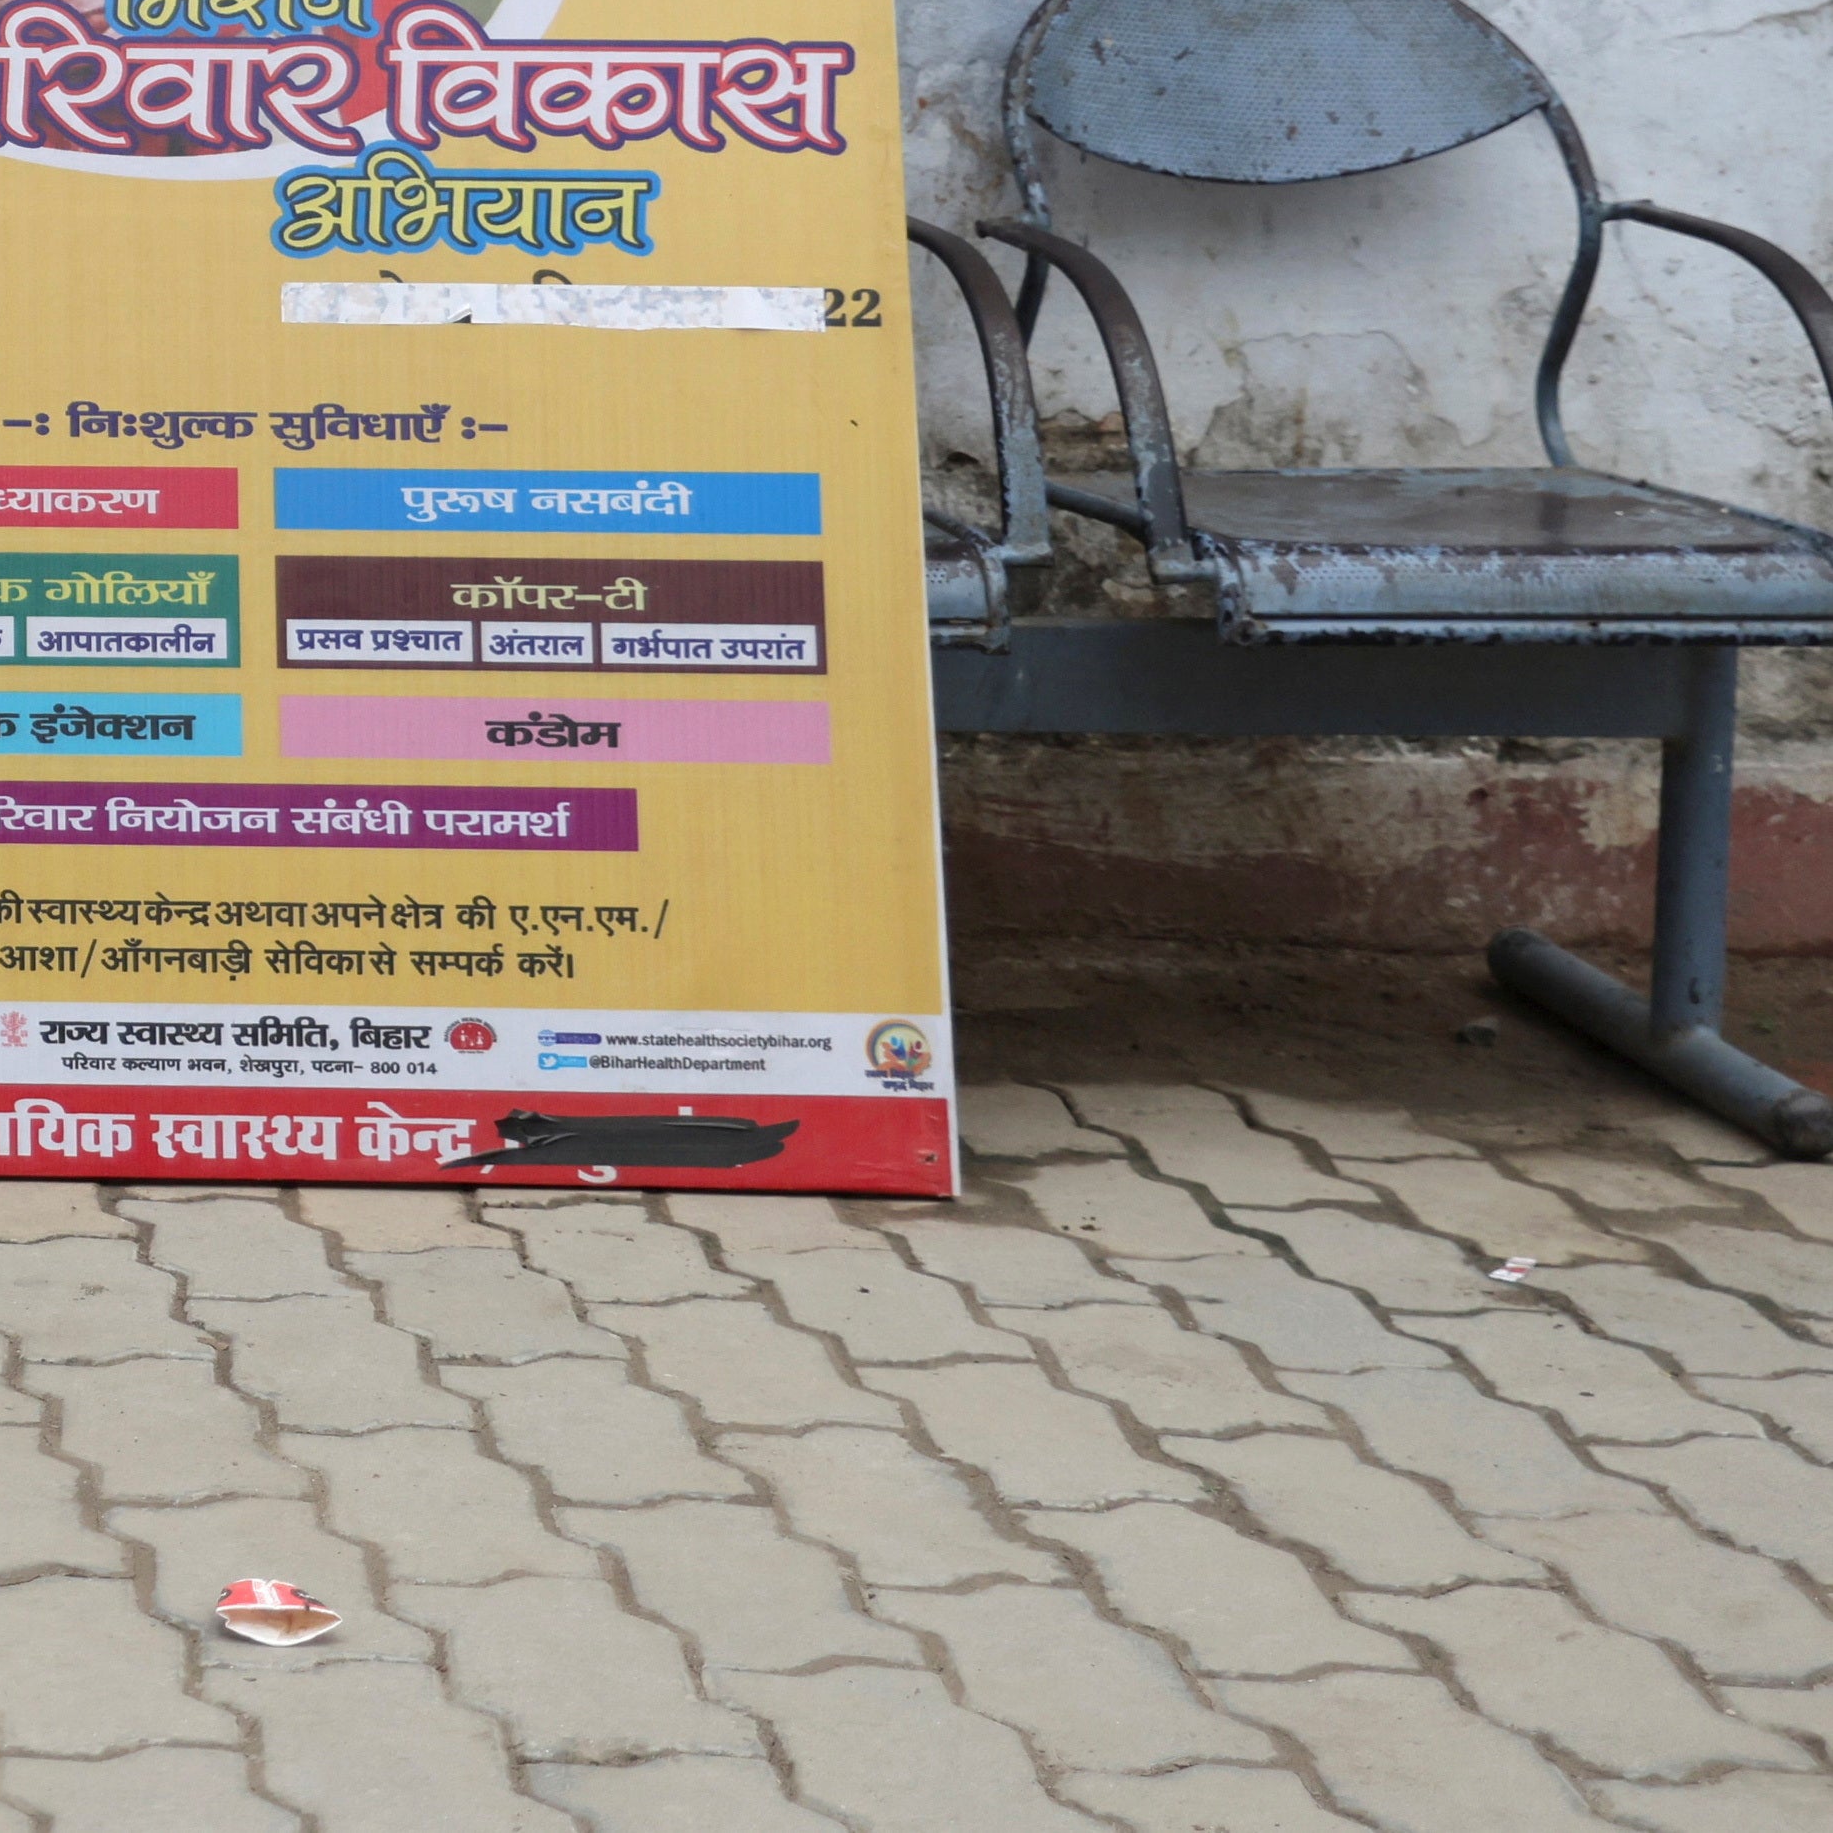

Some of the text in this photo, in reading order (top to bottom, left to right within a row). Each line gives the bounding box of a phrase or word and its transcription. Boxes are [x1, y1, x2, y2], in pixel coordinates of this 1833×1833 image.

[385, 4, 847, 151] विकास
[281, 151, 651, 247] अभियान
[65, 402, 451, 450] निःशुल्क सुविधाएँ
[401, 480, 693, 522] पुरूष नसबंदी
[44, 571, 215, 605] गोलियाँ
[450, 576, 648, 610] कॉपर-टी
[38, 624, 215, 653] आपातकालीन
[489, 629, 584, 656] अंतराल
[485, 715, 621, 748] कंडोम
[105, 803, 279, 833] नियोजन
[290, 805, 413, 834] संबंधी
[423, 806, 570, 837] परामर्श
[39, 1018, 432, 1051] राज्य स्वास्थ्य समिति, बिहार
[606, 1034, 832, 1051] www.statehealthsocietybihar.org
[589, 1055, 766, 1072] @BiharHealthDepartment
[150, 1114, 342, 1160] स्वास्थ्य
